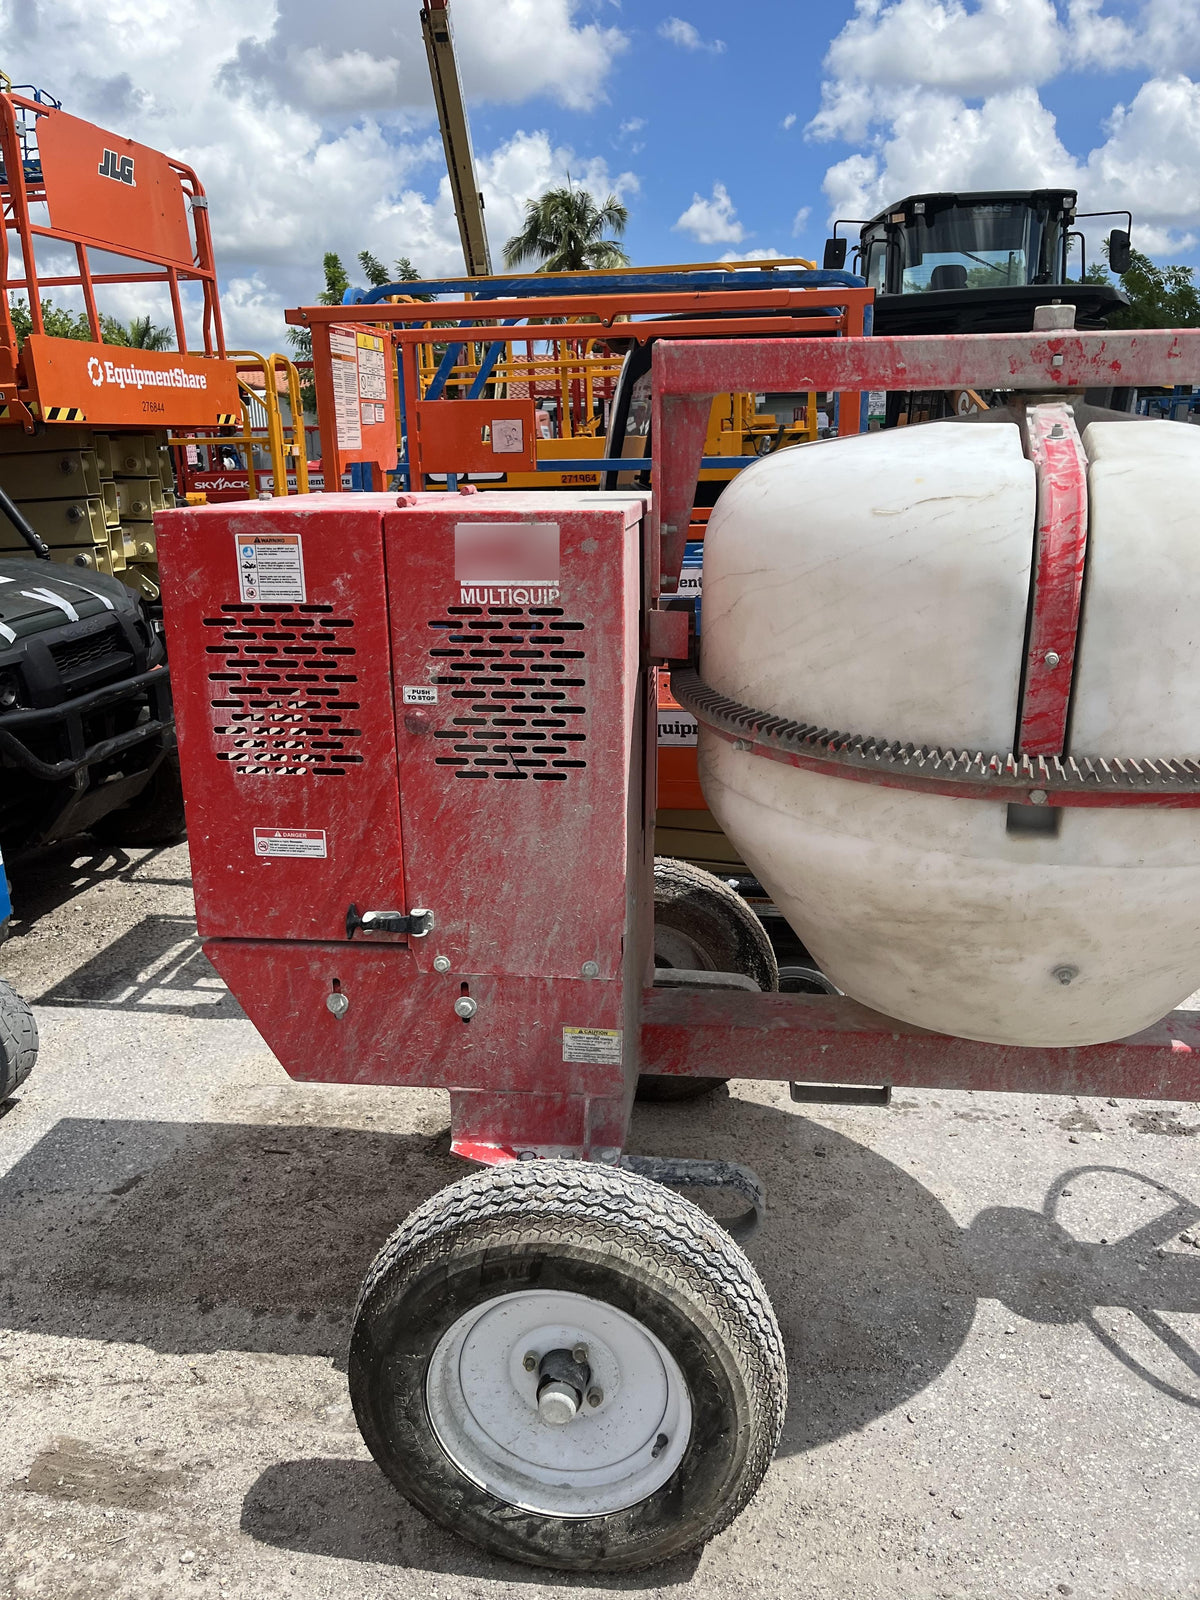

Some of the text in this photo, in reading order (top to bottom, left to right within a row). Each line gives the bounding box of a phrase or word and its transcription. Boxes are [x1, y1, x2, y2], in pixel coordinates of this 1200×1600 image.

[98, 148, 135, 186] JLG
[973, 203, 1012, 214] CASE
[104, 361, 207, 390] EquipmentShare
[142, 401, 165, 413] 276844
[194, 477, 250, 491] SKYJACK
[561, 474, 597, 483] 271964
[460, 588, 560, 605] MULTIQUIP
